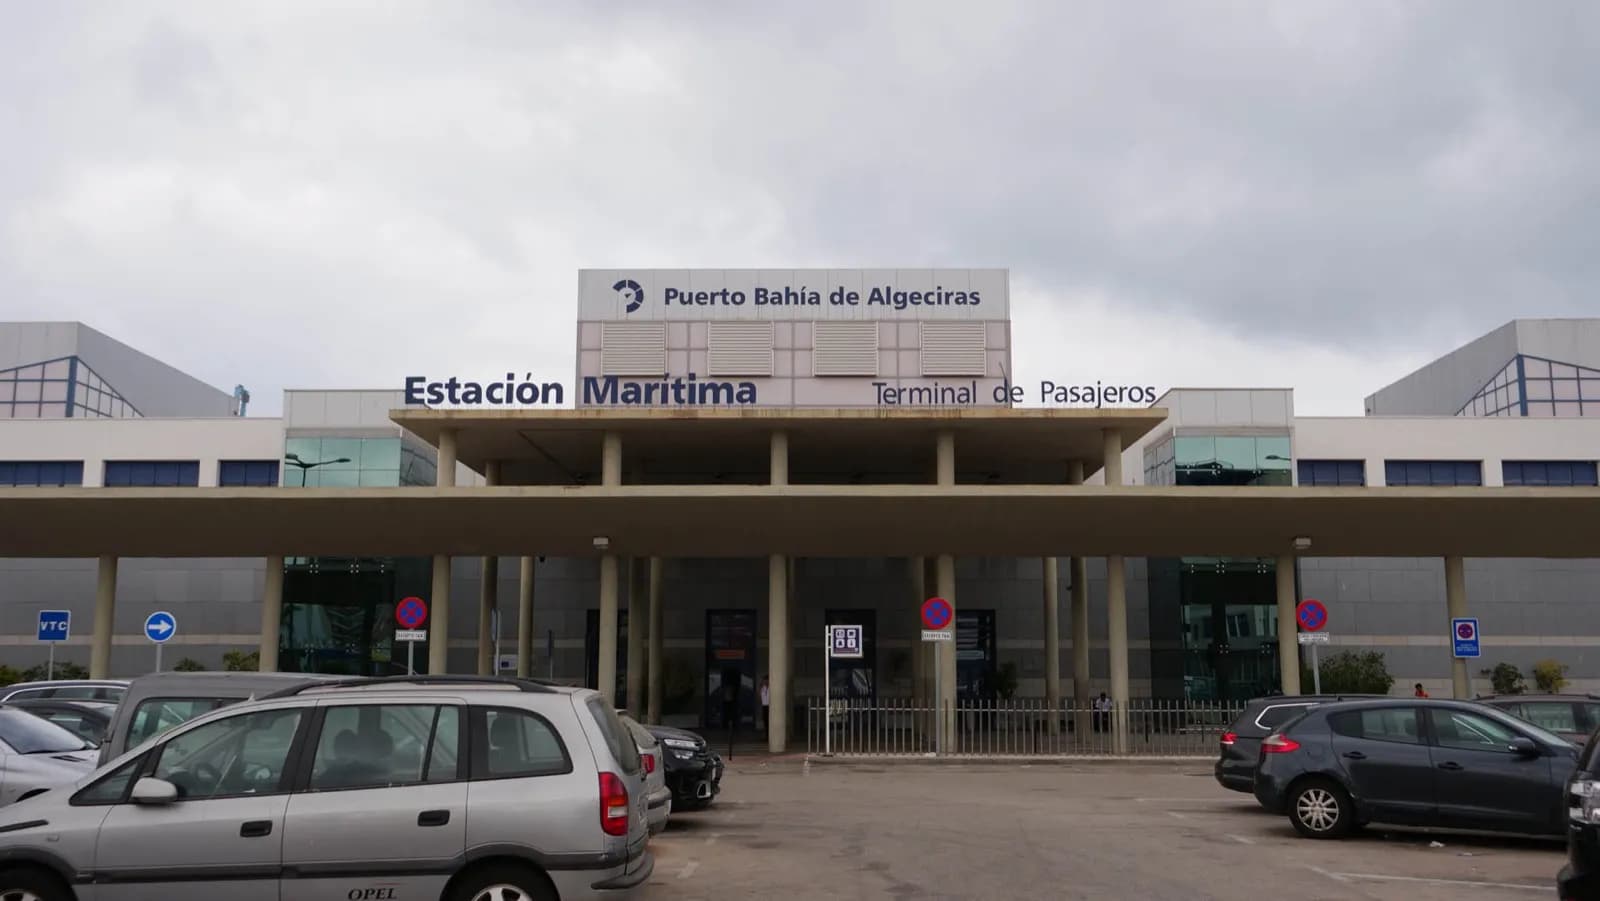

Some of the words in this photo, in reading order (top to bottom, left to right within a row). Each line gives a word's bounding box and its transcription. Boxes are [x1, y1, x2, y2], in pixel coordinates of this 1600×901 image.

[665, 287, 746, 305] Puerto
[755, 286, 821, 305] Bahía
[829, 286, 860, 305] de
[868, 286, 980, 310] Algeciras
[405, 373, 563, 404] Estación
[583, 373, 757, 404] Marítima
[872, 381, 977, 405] Terminal
[993, 381, 1024, 405] de
[1041, 380, 1156, 408] Pasajeros
[40, 621, 67, 631] VTC
[348, 887, 397, 900] OPEL
